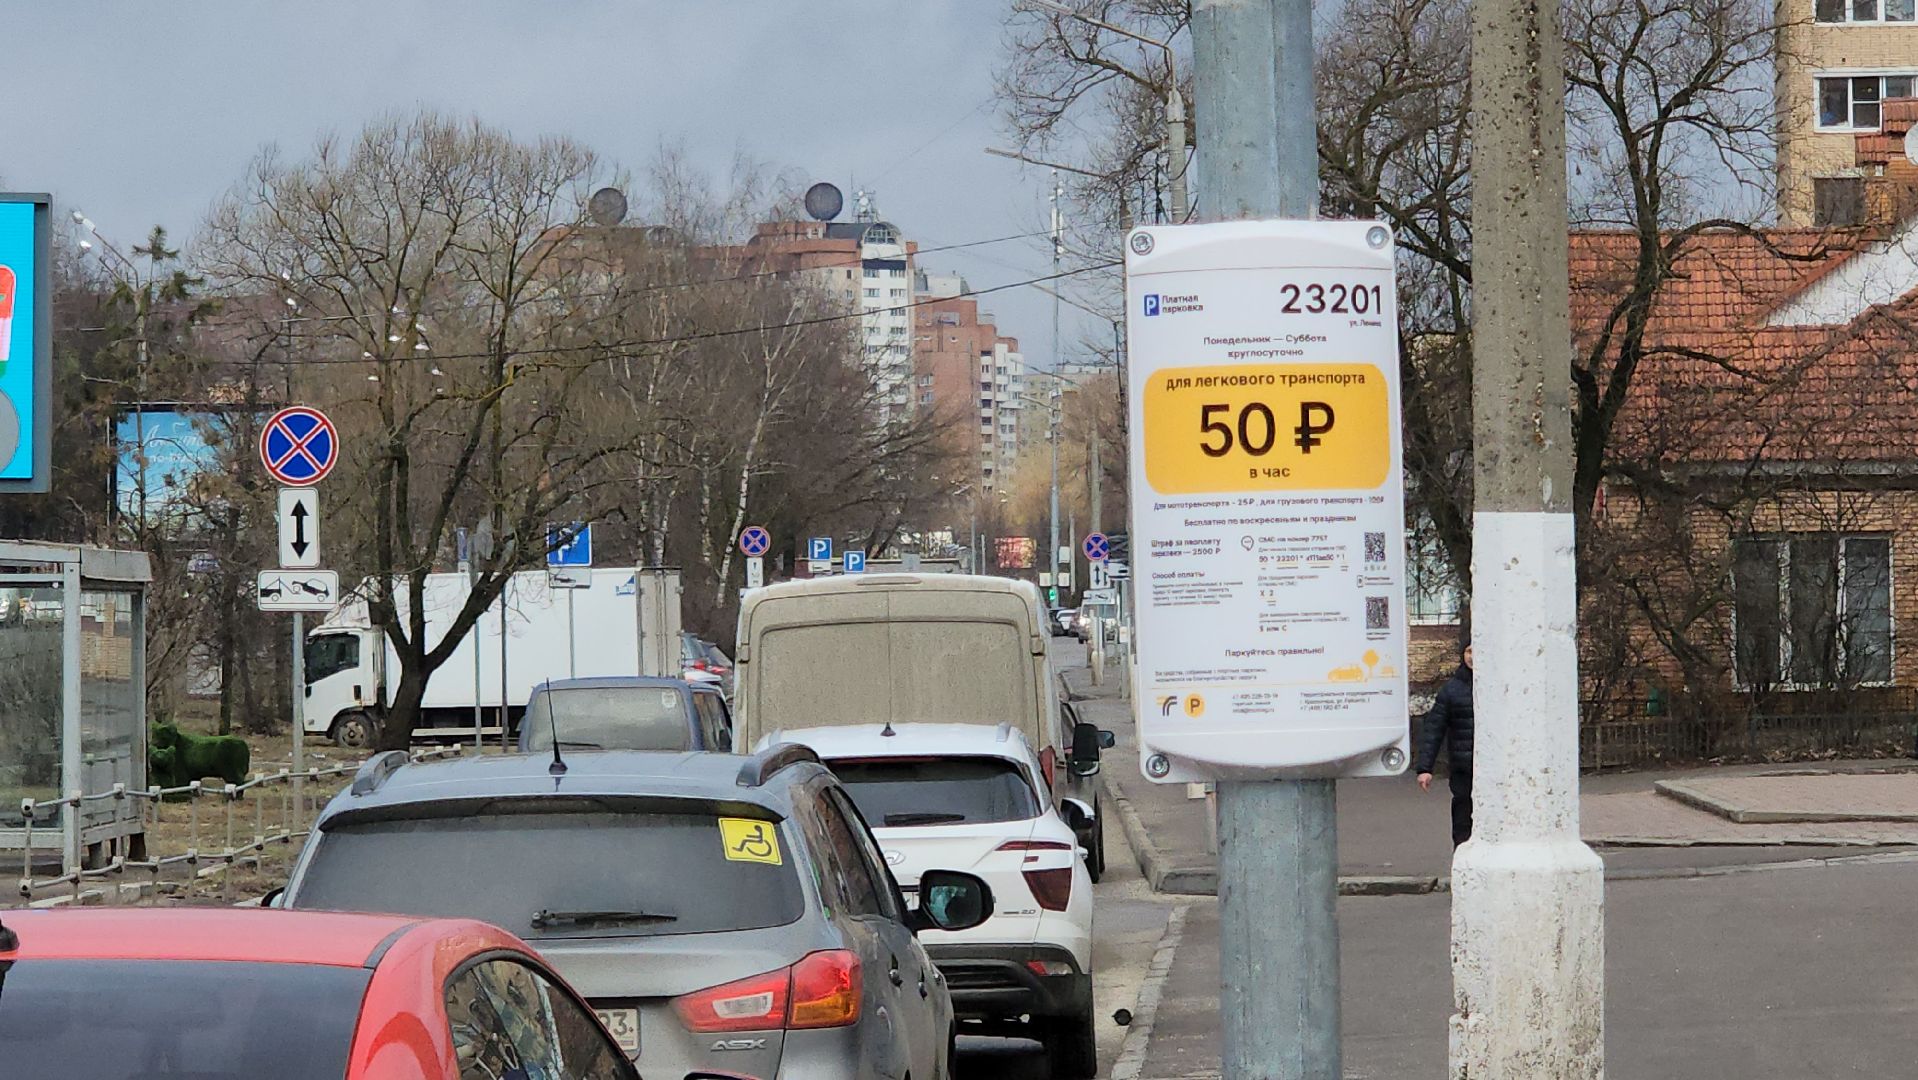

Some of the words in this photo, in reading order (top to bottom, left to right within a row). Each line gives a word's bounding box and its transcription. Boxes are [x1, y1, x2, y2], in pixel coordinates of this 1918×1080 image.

[1162, 295, 1199, 304] Платная
[1280, 283, 1381, 315] 23201
[1162, 305, 1203, 314] парковка
[1203, 336, 1271, 346] Понедельник
[1285, 334, 1327, 344] Суббота
[1228, 349, 1303, 359] круглосуточно
[1166, 377, 1191, 392] для
[1195, 374, 1275, 388] легкового
[1279, 374, 1365, 387] транспорта
[1200, 402, 1276, 458] 50
[1294, 401, 1335, 454] ₽
[1250, 468, 1257, 478] в
[1262, 467, 1290, 478] час
[1154, 502, 1166, 511] Для
[1168, 500, 1230, 510] мототранспорта
[1260, 498, 1275, 507] для
[1277, 497, 1318, 509] грузового
[1321, 497, 1363, 507] транспорта
[1184, 519, 1226, 527] Бесплатно
[1240, 517, 1301, 526] воскресеньям
[1151, 571, 1176, 579] Способ
[1225, 648, 1275, 658] Паркуйтесь
[1278, 646, 1325, 656] правильно!
[711, 1038, 767, 1051] ASX
